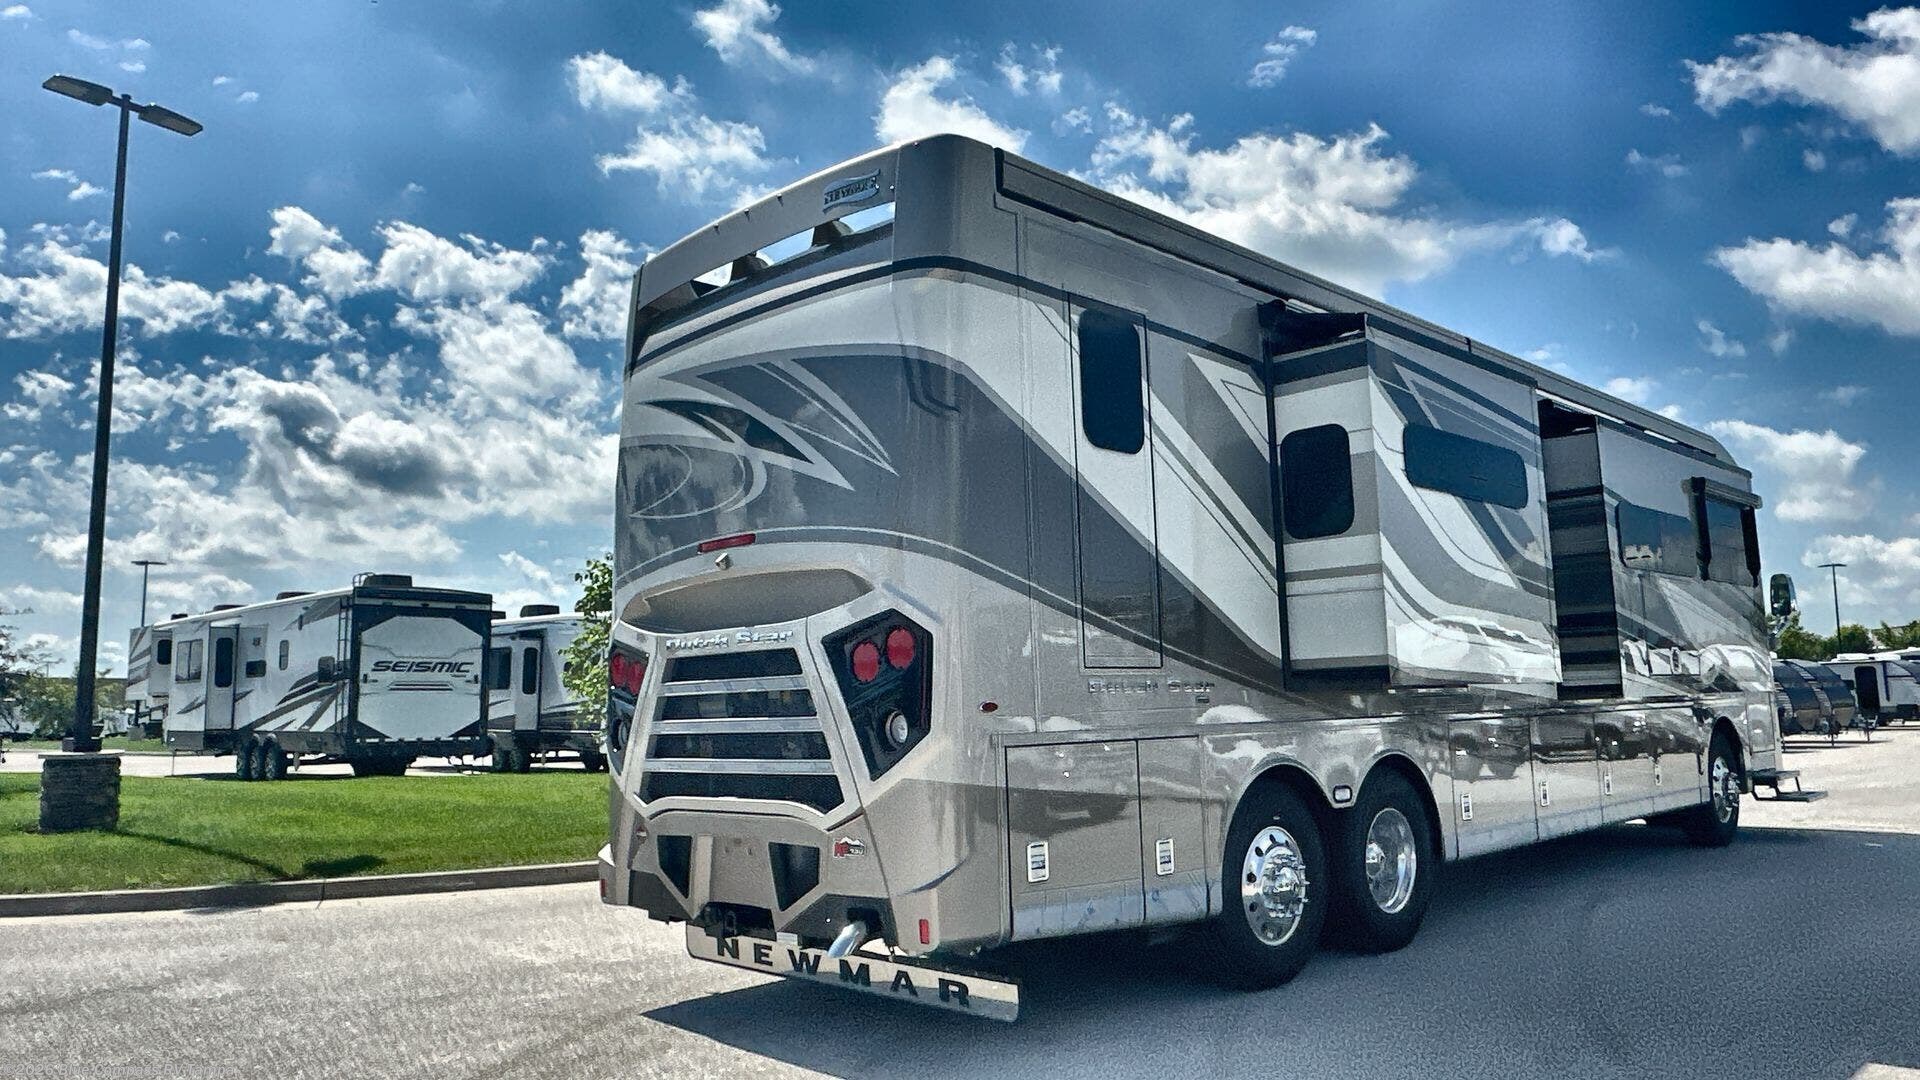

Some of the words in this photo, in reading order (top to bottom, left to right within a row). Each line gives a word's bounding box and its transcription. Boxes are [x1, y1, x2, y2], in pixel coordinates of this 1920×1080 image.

[735, 630, 794, 645] Star
[371, 660, 475, 673] SEISMIC
[717, 937, 970, 1008] NEWMAR
